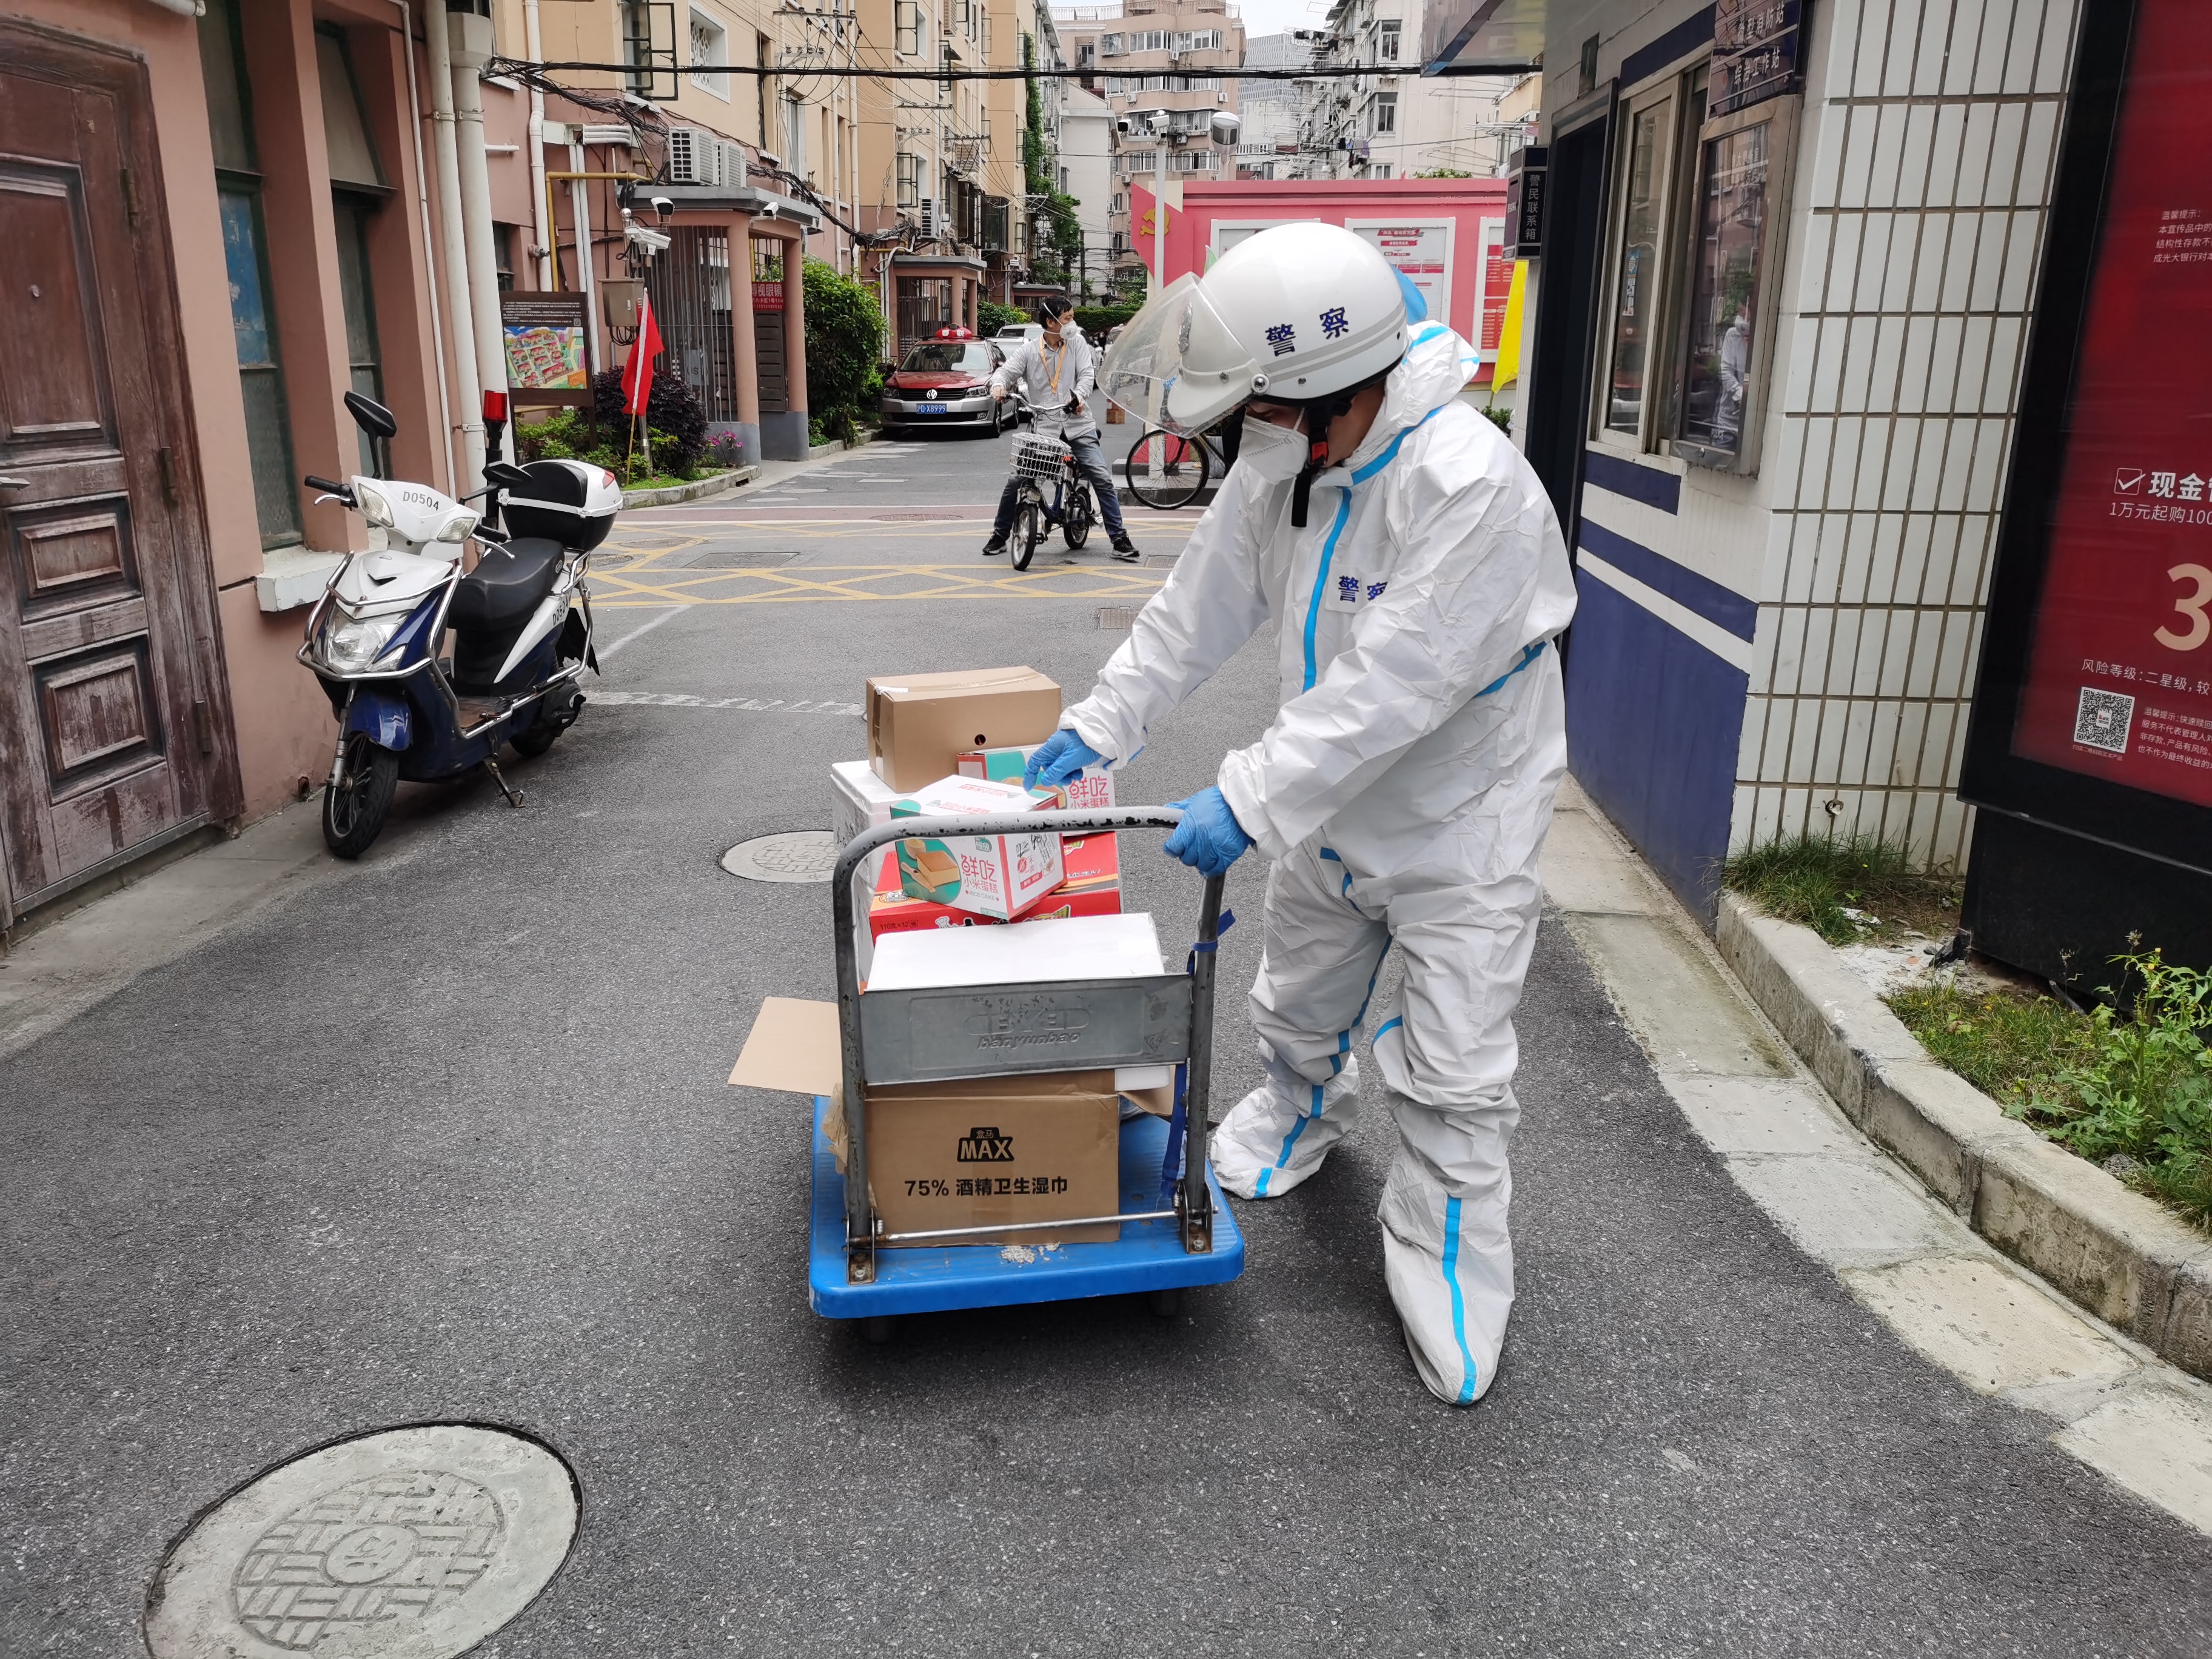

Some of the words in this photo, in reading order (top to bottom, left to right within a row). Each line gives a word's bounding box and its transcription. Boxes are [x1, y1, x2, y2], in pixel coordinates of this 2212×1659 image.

[1525, 175, 1541, 240] 警民联系箱
[2158, 223, 2212, 234] 本宣传品中的
[2156, 237, 2212, 249] 结构性存款不
[1265, 306, 1349, 357] 警察
[2148, 471, 2212, 503] 现金
[403, 491, 439, 511] D0504
[552, 595, 569, 626] D0504
[2153, 563, 2212, 652] 3
[2081, 659, 2212, 696] 风险等级：二星级，较
[2143, 706, 2212, 730] 温馨提示：快速赎回
[1069, 775, 1109, 800] 鲜吃
[1071, 797, 1110, 809] 小米蛋糕
[961, 854, 997, 882] 鲜吃
[964, 877, 999, 894] 小米蛋糕
[976, 1130, 994, 1139] 盒马
[960, 1140, 1010, 1160] MAX
[904, 1179, 949, 1197] 75%
[956, 1176, 1068, 1197] 酒精卫生湿巾
